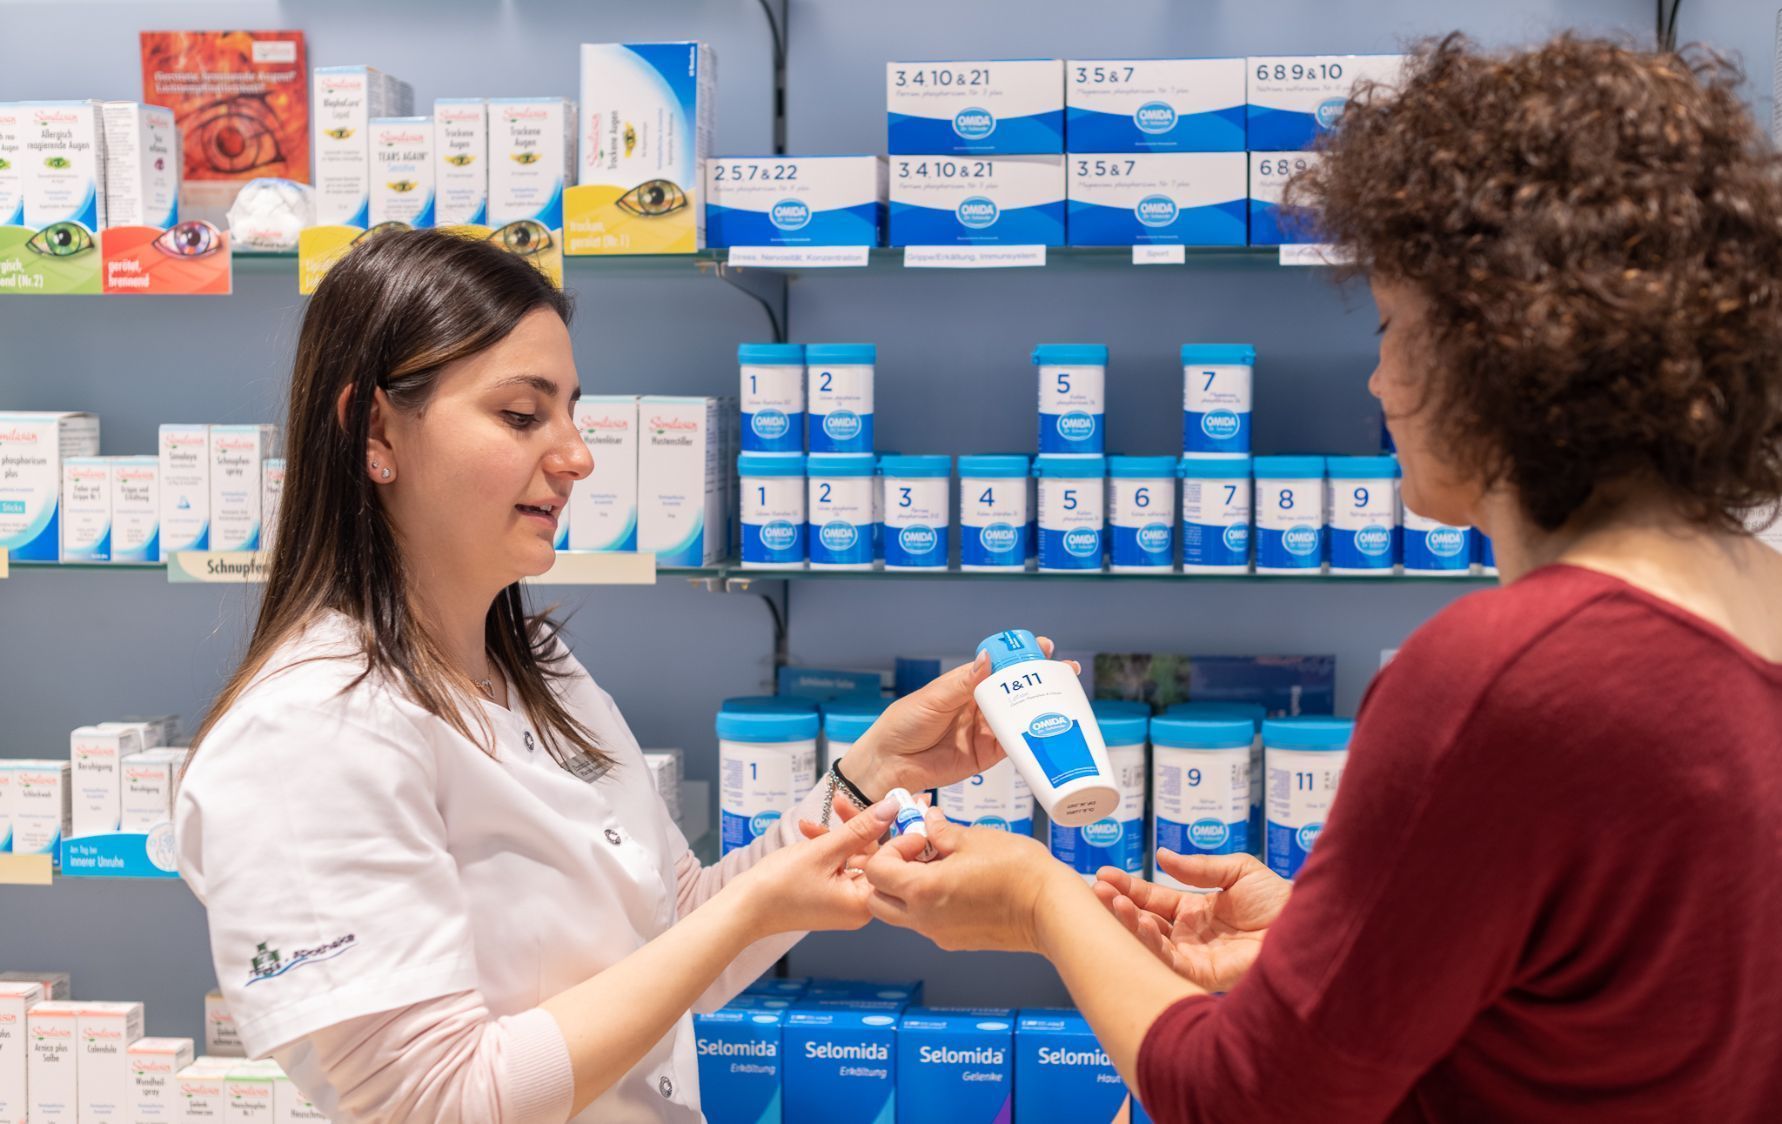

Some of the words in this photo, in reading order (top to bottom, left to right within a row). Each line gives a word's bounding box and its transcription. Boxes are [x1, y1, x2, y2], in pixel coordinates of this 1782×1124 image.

[931, 70, 953, 86] 10
[956, 73, 966, 86] &
[970, 69, 990, 86] 21
[1094, 67, 1105, 83] 5
[1109, 71, 1119, 83] &
[1123, 67, 1135, 83] 7
[1291, 64, 1304, 80] 9
[1307, 69, 1316, 80] &
[1320, 63, 1343, 80] 10
[957, 115, 991, 126] OMIDA
[1138, 109, 1173, 121] OMIDA
[748, 165, 759, 181] 7
[761, 169, 771, 181] &
[774, 165, 798, 181] 22
[935, 161, 957, 177] 10
[960, 165, 970, 177] &
[973, 161, 993, 177] 21
[1095, 160, 1107, 176] 5
[1110, 164, 1120, 176] &
[1124, 160, 1136, 176] 7
[774, 206, 807, 217] OMIDA
[961, 204, 994, 215] OMIDA
[1140, 203, 1174, 214] OMIDA
[750, 374, 757, 394] 1
[819, 371, 832, 392] 2
[1057, 374, 1070, 394] 5
[1202, 371, 1216, 391] 7
[756, 416, 785, 427] OMIDA
[827, 417, 857, 427] OMIDA
[1062, 418, 1092, 429] OMIDA
[1206, 416, 1236, 427] OMIDA
[758, 486, 765, 506] 1
[819, 483, 831, 503] 2
[899, 487, 912, 508] 3
[979, 487, 995, 507] 4
[1063, 490, 1077, 510] 5
[1134, 487, 1149, 508] 6
[1224, 485, 1237, 505] 7
[1279, 489, 1294, 510] 8
[1353, 487, 1369, 508] 9
[765, 527, 793, 538] OMIDA
[824, 528, 853, 539] OMIDA
[903, 531, 933, 542] OMIDA
[984, 530, 1014, 541] OMIDA
[1068, 533, 1096, 545] OMIDA
[1141, 529, 1168, 540] OMIDA
[1287, 531, 1316, 543] OMIDA
[1359, 531, 1387, 543] OMIDA
[1430, 531, 1461, 544] OMIDA
[1032, 716, 1067, 731] OMIDA
[750, 763, 757, 780] 1
[1187, 768, 1202, 787] 9
[1295, 772, 1313, 791] 11
[1086, 824, 1118, 835] OMIDA
[1192, 825, 1225, 836] OMIDA
[697, 1039, 777, 1057] Selomida
[805, 1041, 889, 1060] Selomida
[919, 1046, 1004, 1065] Selomida
[1038, 1046, 1114, 1066] Selomid
[962, 1071, 1003, 1082] Gelenke
